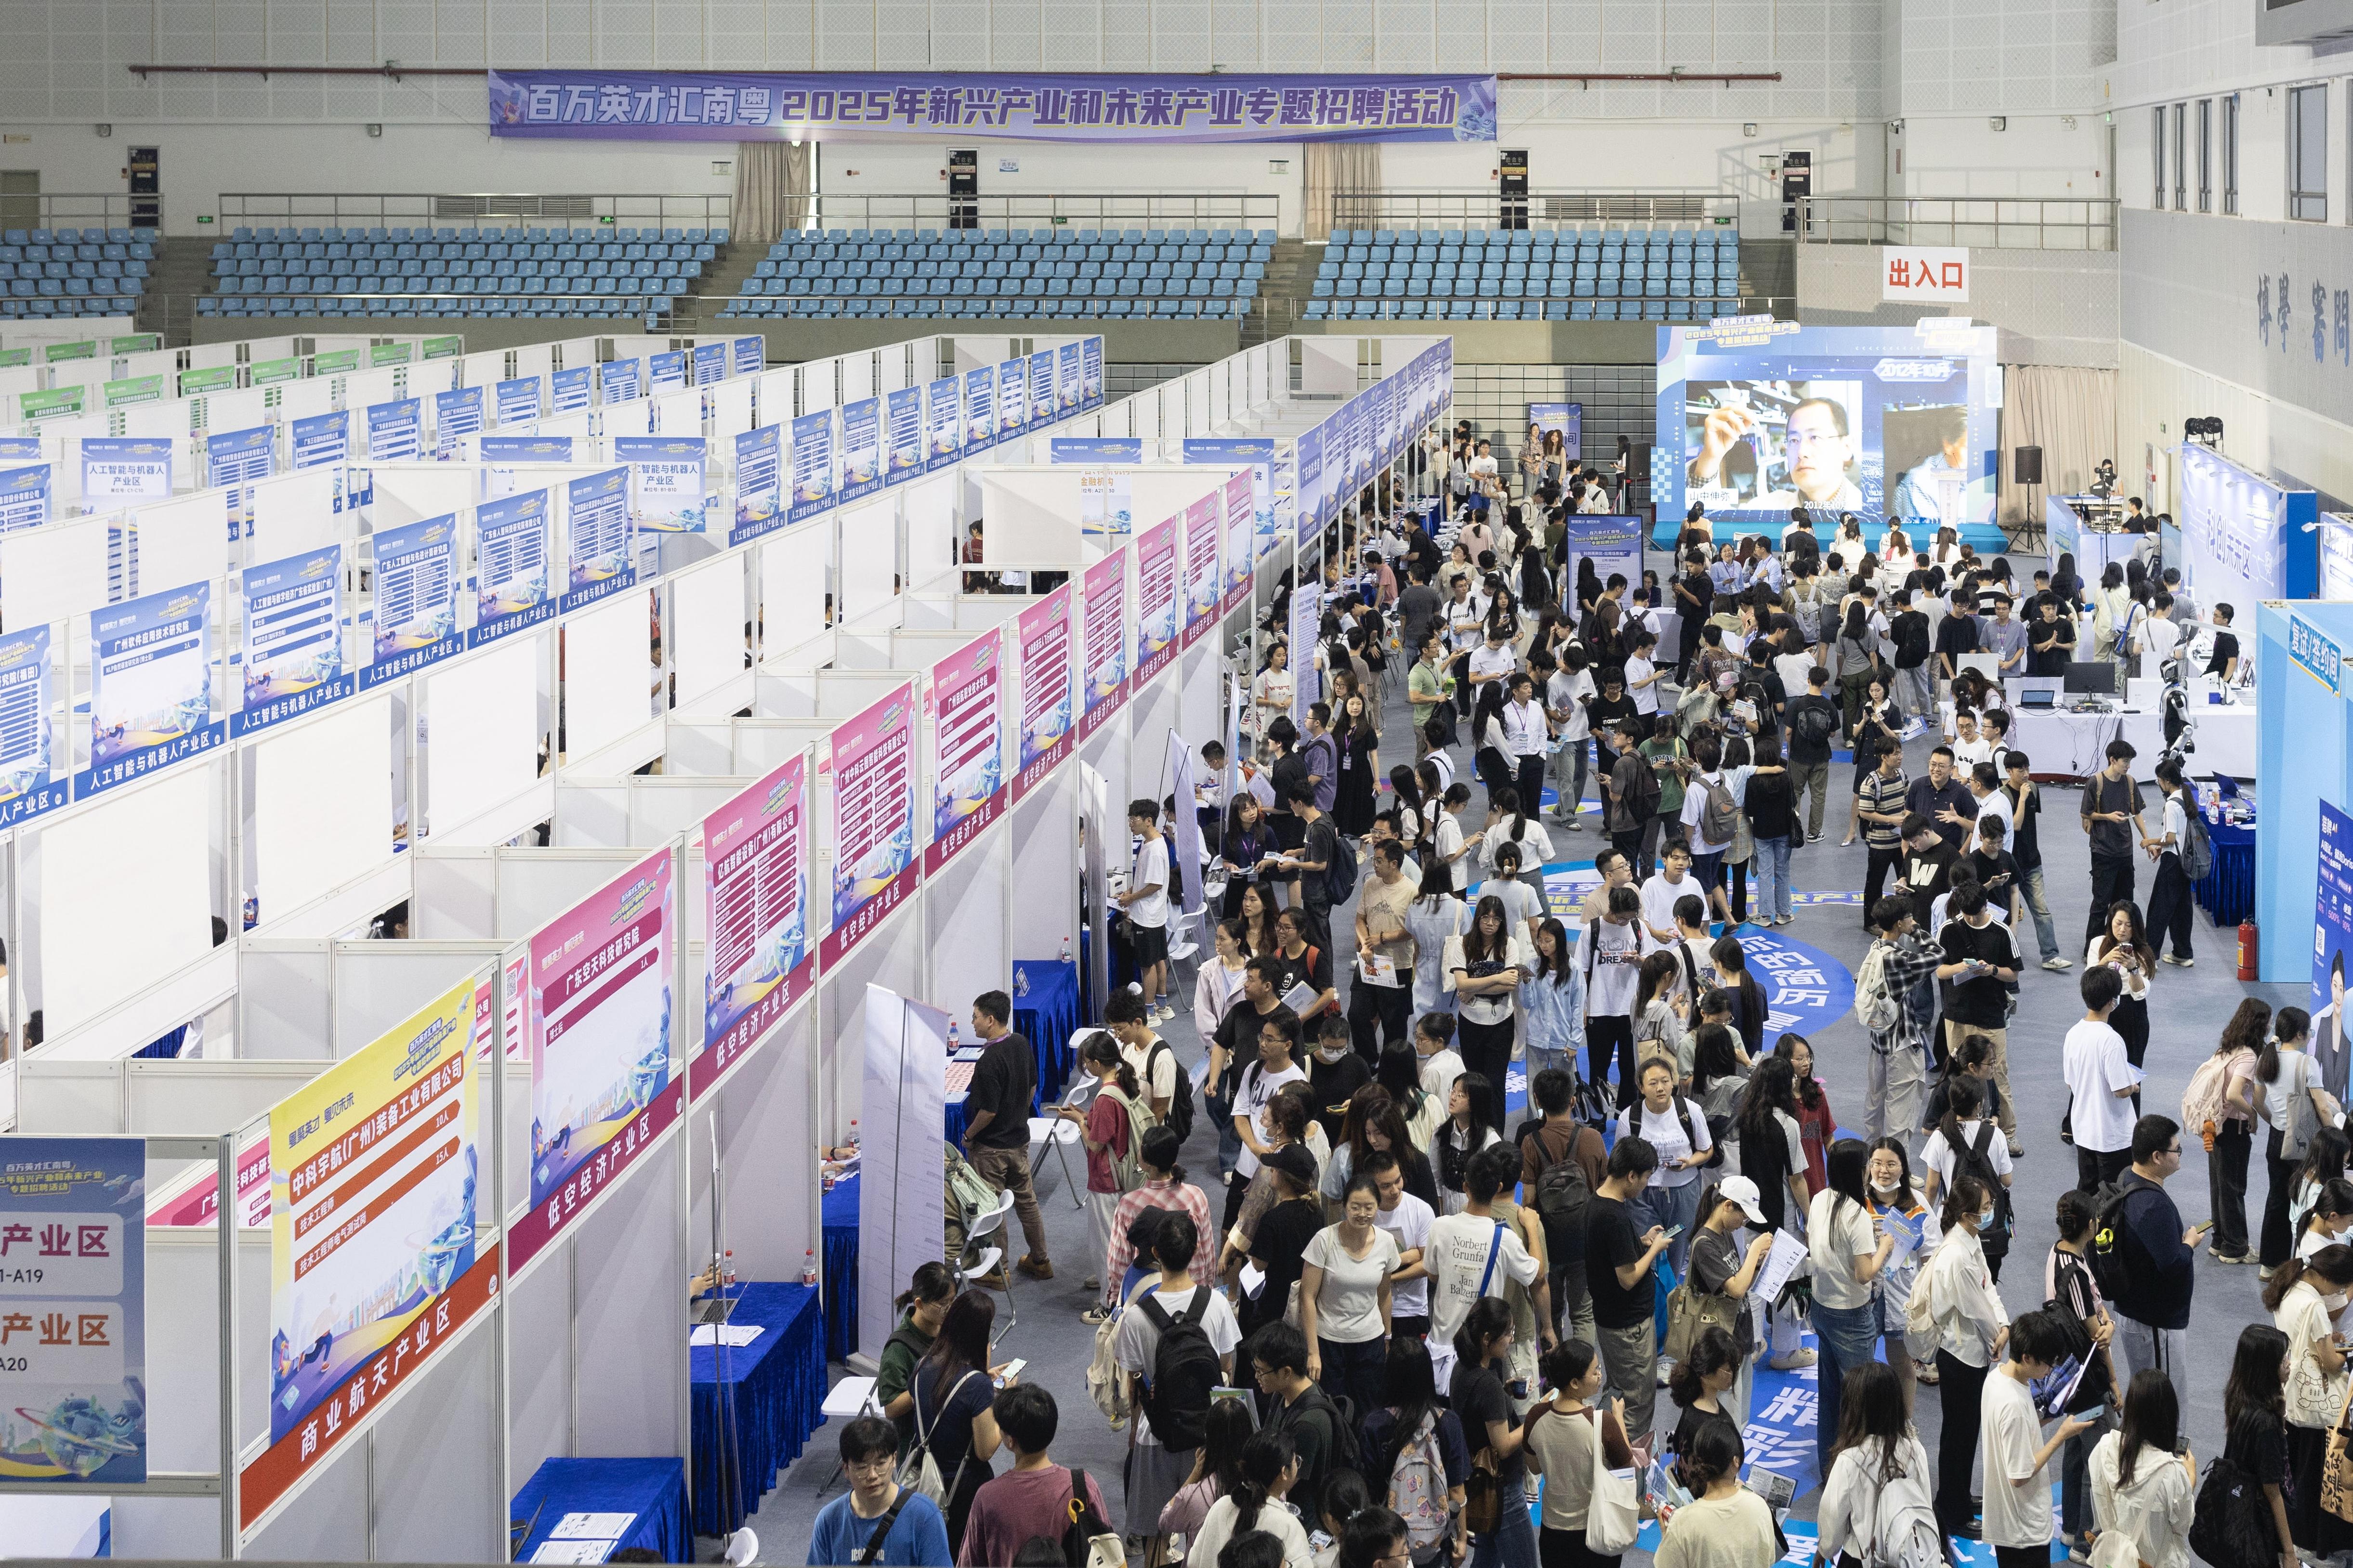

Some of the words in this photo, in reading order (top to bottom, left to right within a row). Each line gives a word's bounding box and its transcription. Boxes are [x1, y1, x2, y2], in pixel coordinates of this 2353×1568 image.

[528, 84, 771, 125] 百万英才汇南粤
[782, 86, 1457, 126] 2025年新兴产业和未来产业专题招聘活动
[1889, 259, 1962, 289] 出入口
[1713, 315, 1770, 326] 百万英才汇南粤
[90, 465, 164, 475] 人工智能与机器人
[113, 477, 141, 486] 产业区
[628, 464, 697, 474] 智能与机器人
[646, 476, 674, 485] 产业区
[842, 481, 878, 501] 人工智能与机器人产业区
[1689, 491, 1730, 502] 山中伸弥
[791, 497, 831, 520] 人工智能与机器人产业区
[734, 516, 779, 543] 人工智能与机器人产业区
[2206, 509, 2250, 579] 科创未来区
[566, 574, 627, 609] 人工智能与机器人产业区
[114, 620, 189, 653] 广州软件应用技术研究院
[476, 605, 547, 642] 人工智能与机器人产业区
[1189, 610, 1213, 641] 低空经济产业区
[369, 640, 453, 683] 人工智能与机器人产业区
[1141, 648, 1170, 681] 低空经济产业区
[2292, 622, 2338, 683] 复试/签约间
[242, 682, 341, 731] 人工智能与机器人产业区
[948, 673, 987, 712] 广州民航职业技术学院
[1088, 689, 1119, 730] 低空经济产业区
[90, 731, 210, 790] 人工智能与机器人产业区
[840, 728, 906, 789] 广州中科云图智能科技有限公司
[1024, 741, 1063, 789] 低空经济产业区
[1, 791, 49, 823] 人产业区
[718, 810, 794, 880] 亿航智能设备(广州)有限公司
[942, 801, 991, 859] 低空经济产业区
[1910, 858, 1939, 886] W
[841, 879, 900, 951] 低空经济产业区
[566, 926, 640, 995] 广东空天科技研究院
[1601, 955, 1626, 964] DREA
[477, 999, 488, 1018] 公司
[550, 1021, 563, 1042] 博士后
[641, 957, 648, 969] 1人
[409, 1018, 442, 1051] 百万英才汇南粤
[716, 980, 789, 1070] 低空经济产业区
[394, 1018, 457, 1081] 2025年新兴产业和未来产业
[289, 1114, 320, 1149] 粤聚英才
[324, 1092, 355, 1124] 粤见未来
[292, 1057, 462, 1196] 中科宇航(广州)装备工业有限公司
[6, 1161, 71, 1172] 百万英才汇南粤
[300, 1196, 334, 1232] 技术工程师
[436, 1111, 449, 1128] 10人
[548, 1112, 650, 1230] 低空经济产业区
[10, 1183, 68, 1194] 专题招聘活动
[300, 1212, 367, 1274] 技术工程师电气测试岗
[435, 1148, 449, 1165] 15人
[1, 1223, 110, 1257] 产业区
[1452, 1248, 1484, 1262] Grunfa
[1453, 1235, 1488, 1252] Norbert
[1459, 1274, 1473, 1288] Jan
[1, 1313, 110, 1346] 产业区
[301, 1297, 449, 1462] 商业航天产业区
